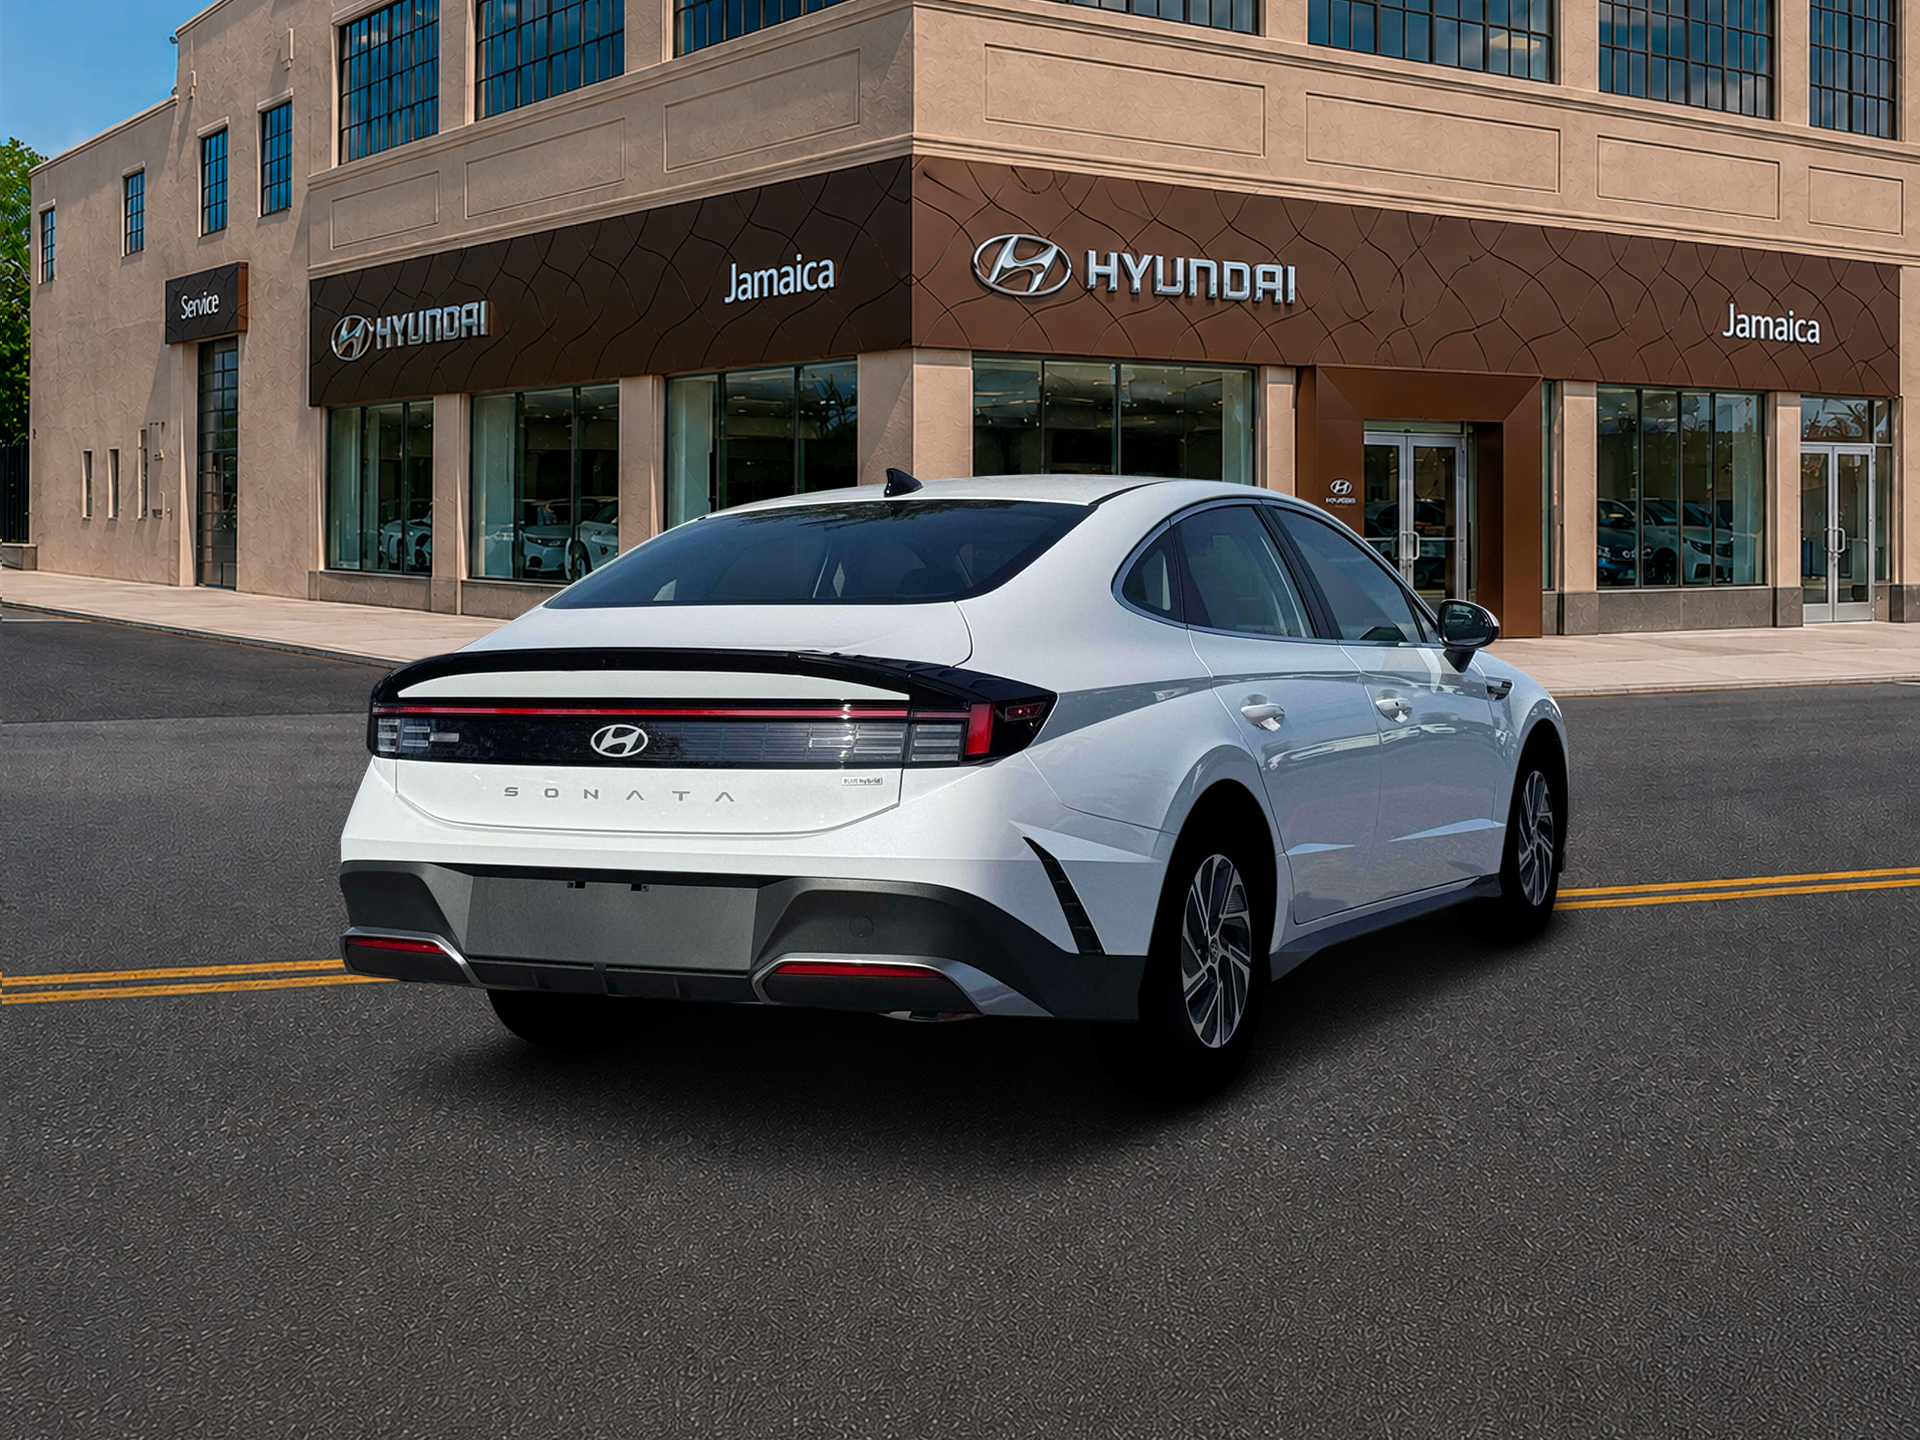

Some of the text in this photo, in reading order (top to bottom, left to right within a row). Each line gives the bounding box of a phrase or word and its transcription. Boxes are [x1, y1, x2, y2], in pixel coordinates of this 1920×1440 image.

[723, 253, 836, 304] Jamaica
[1085, 249, 1297, 305] HYUNDAI
[180, 290, 220, 320] Service
[375, 300, 489, 349] HYUNDAI
[1721, 302, 1821, 345] Jamaica
[503, 786, 736, 803] SONATA
